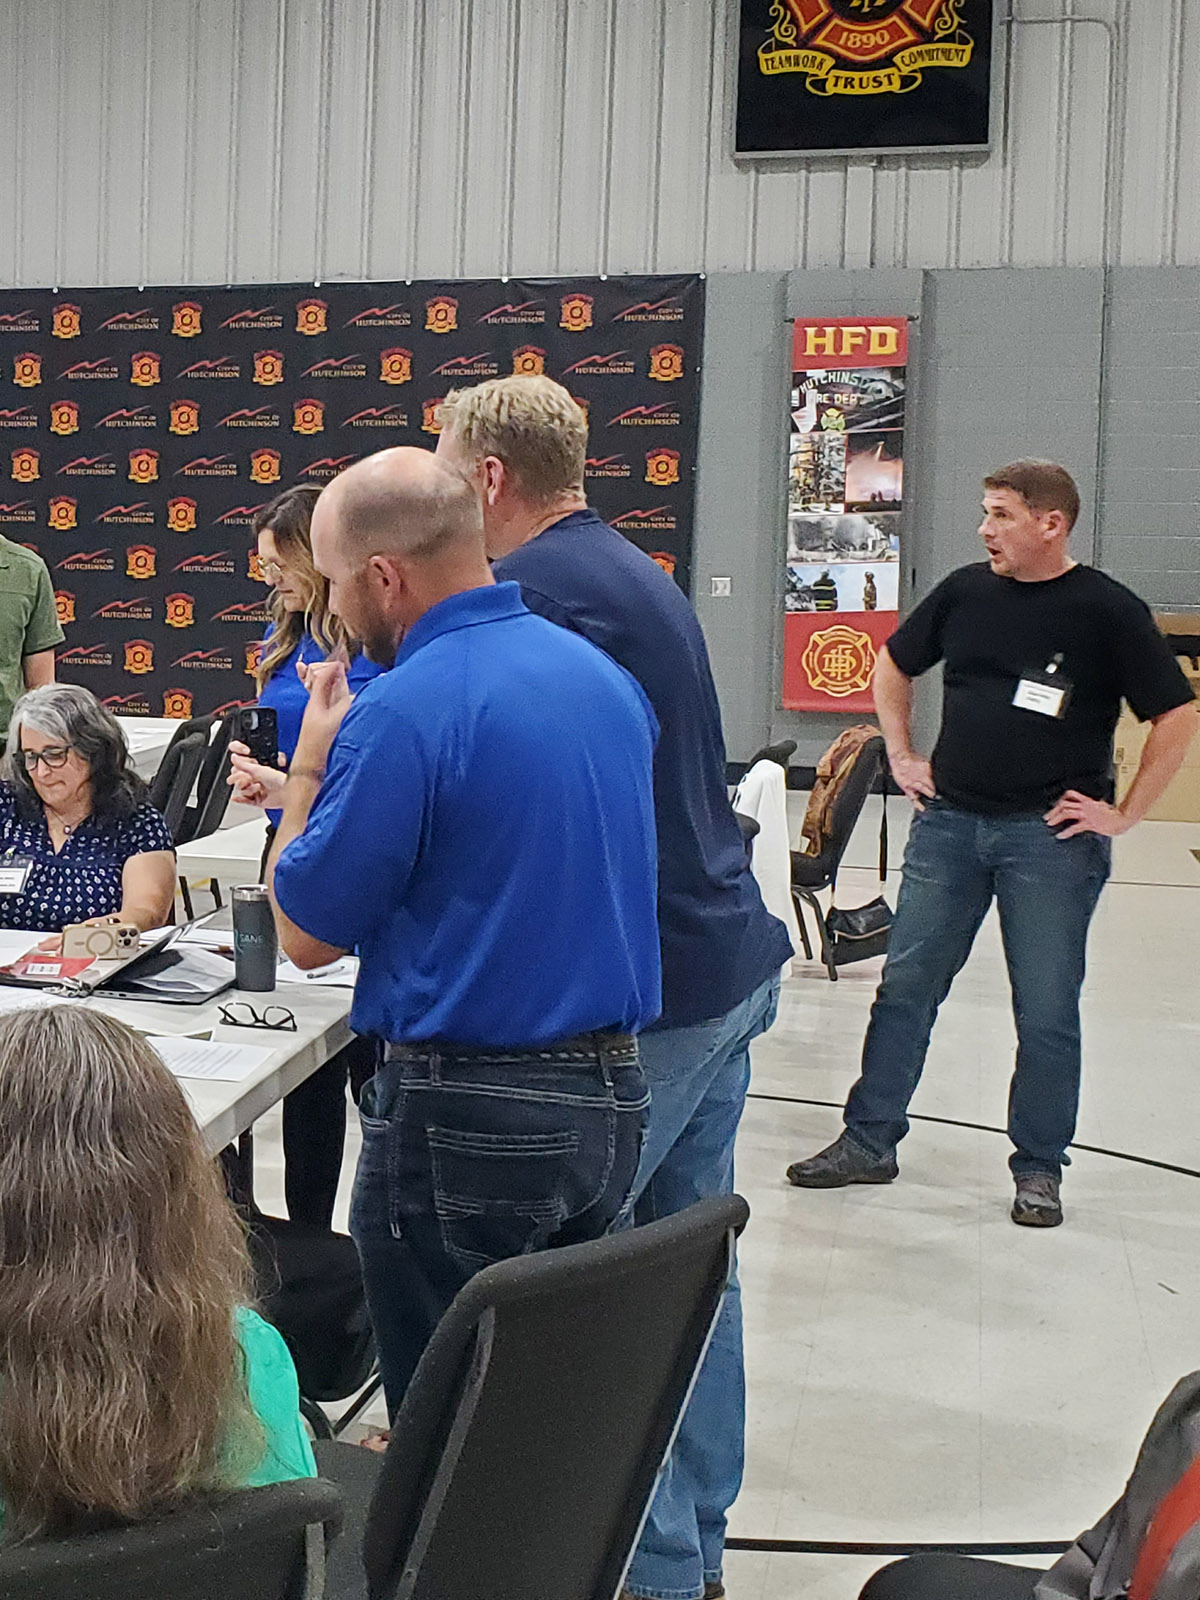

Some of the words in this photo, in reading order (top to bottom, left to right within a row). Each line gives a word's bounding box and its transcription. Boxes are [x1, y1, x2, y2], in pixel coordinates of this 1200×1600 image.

[839, 30, 889, 48] 1890
[764, 53, 827, 71] TEAMWORK
[901, 47, 966, 67] COMMITMENT
[832, 72, 896, 89] TRUST
[803, 325, 899, 356] HFD
